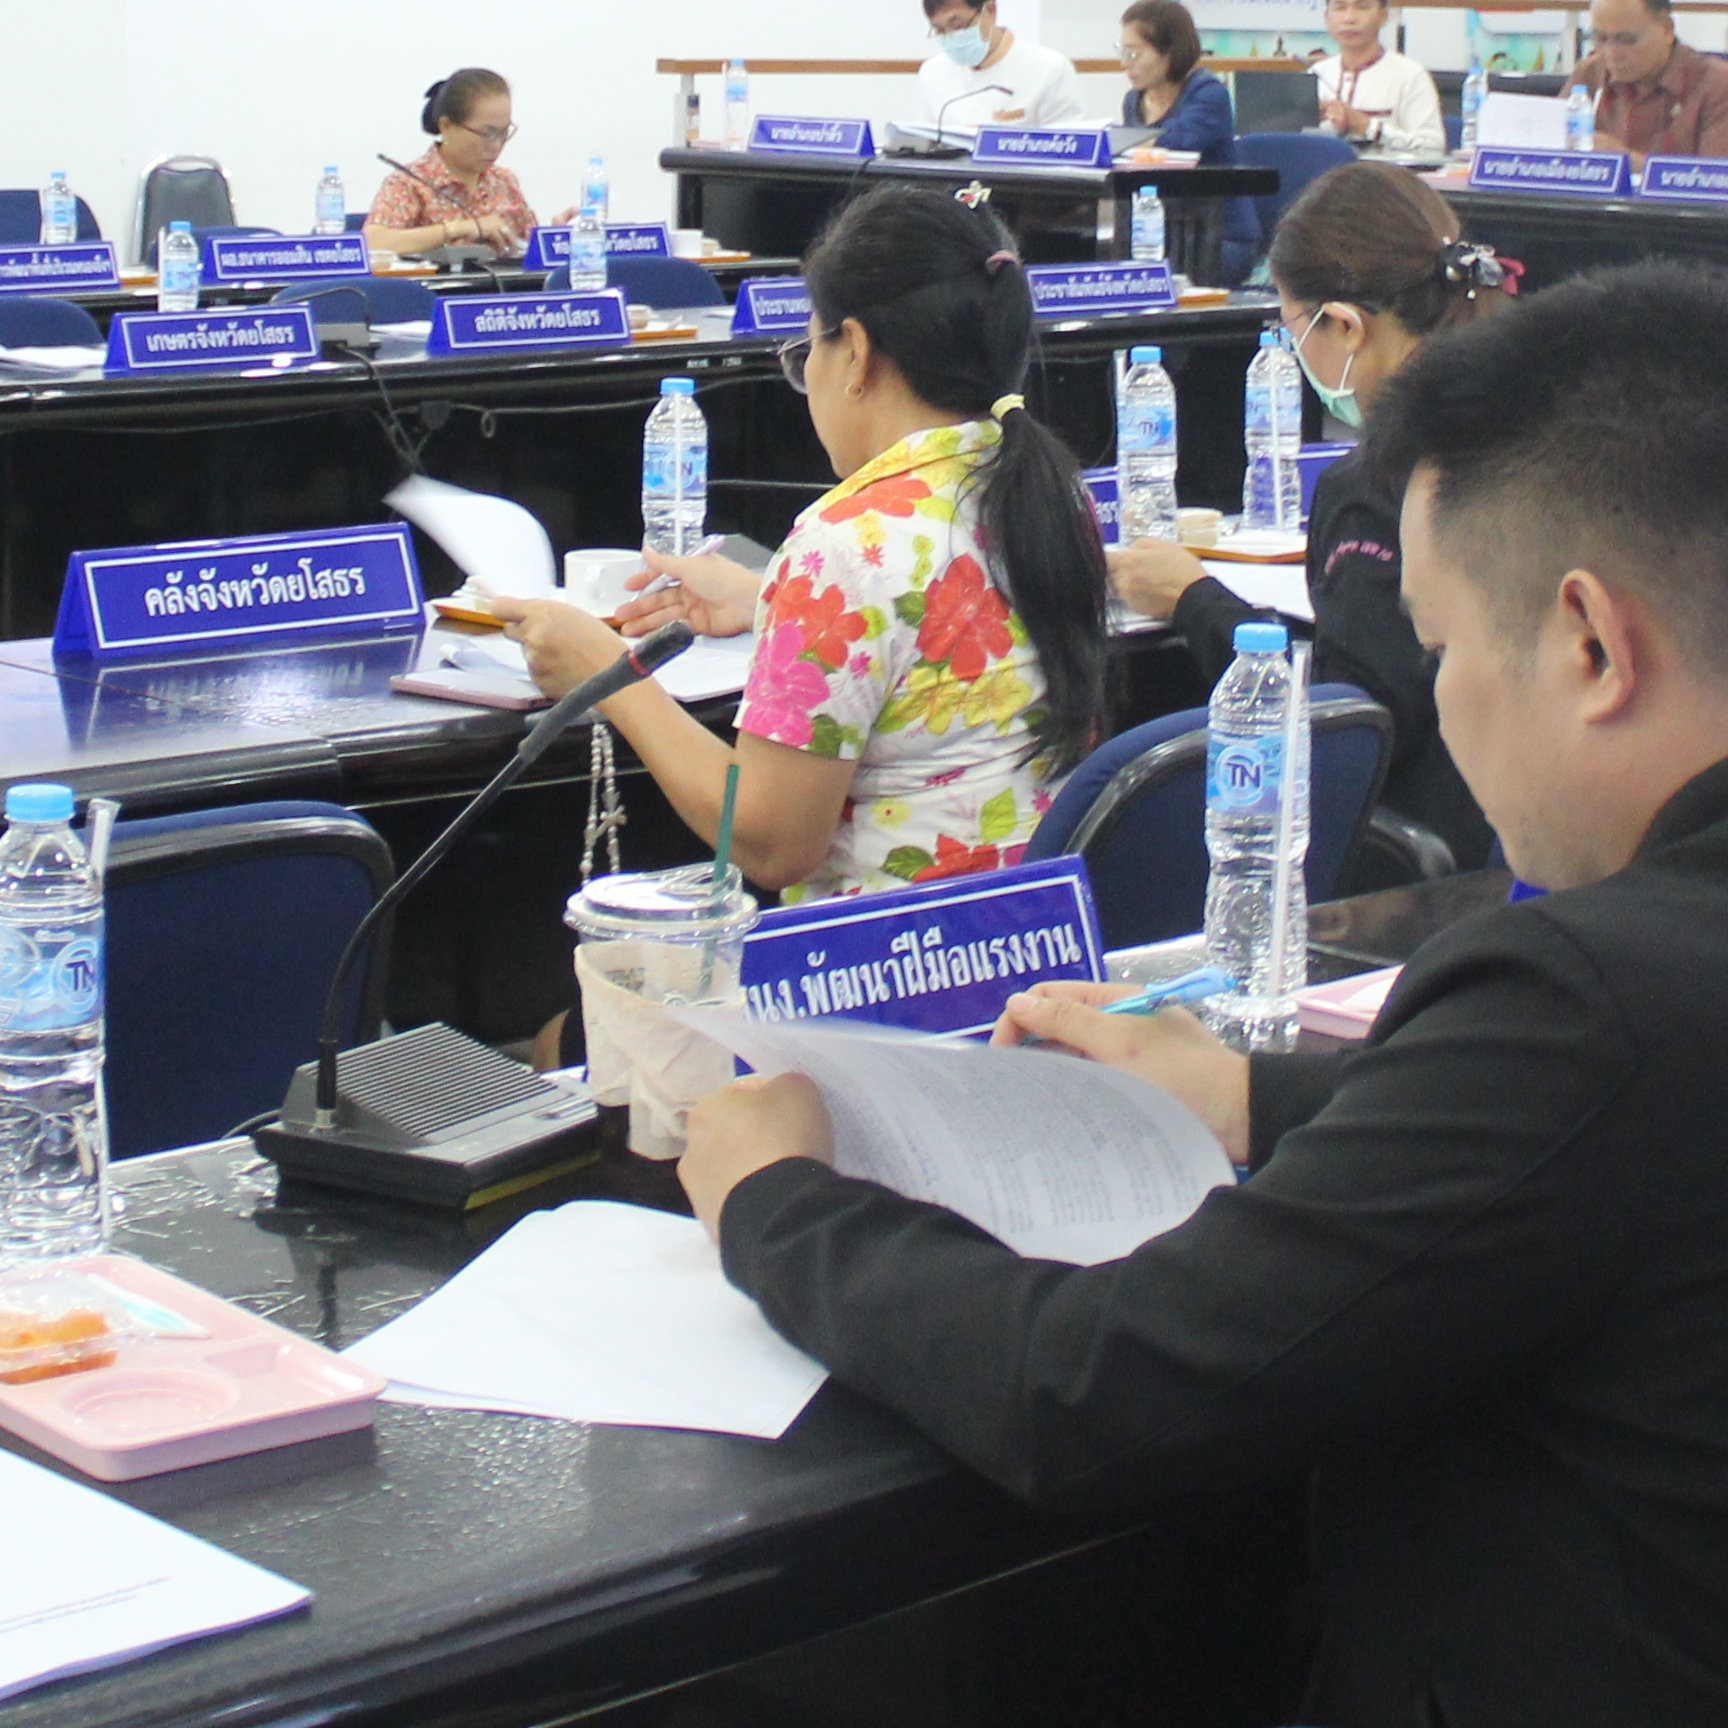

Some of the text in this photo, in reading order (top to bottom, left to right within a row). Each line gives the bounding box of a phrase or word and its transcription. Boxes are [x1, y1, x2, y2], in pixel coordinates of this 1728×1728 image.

[473, 302, 601, 333] สถิติจังหวัดยโสธร
[145, 320, 294, 353] เกษตรจังหวัดยโสธร
[144, 556, 367, 617] คลังจังหวัดยโสธร
